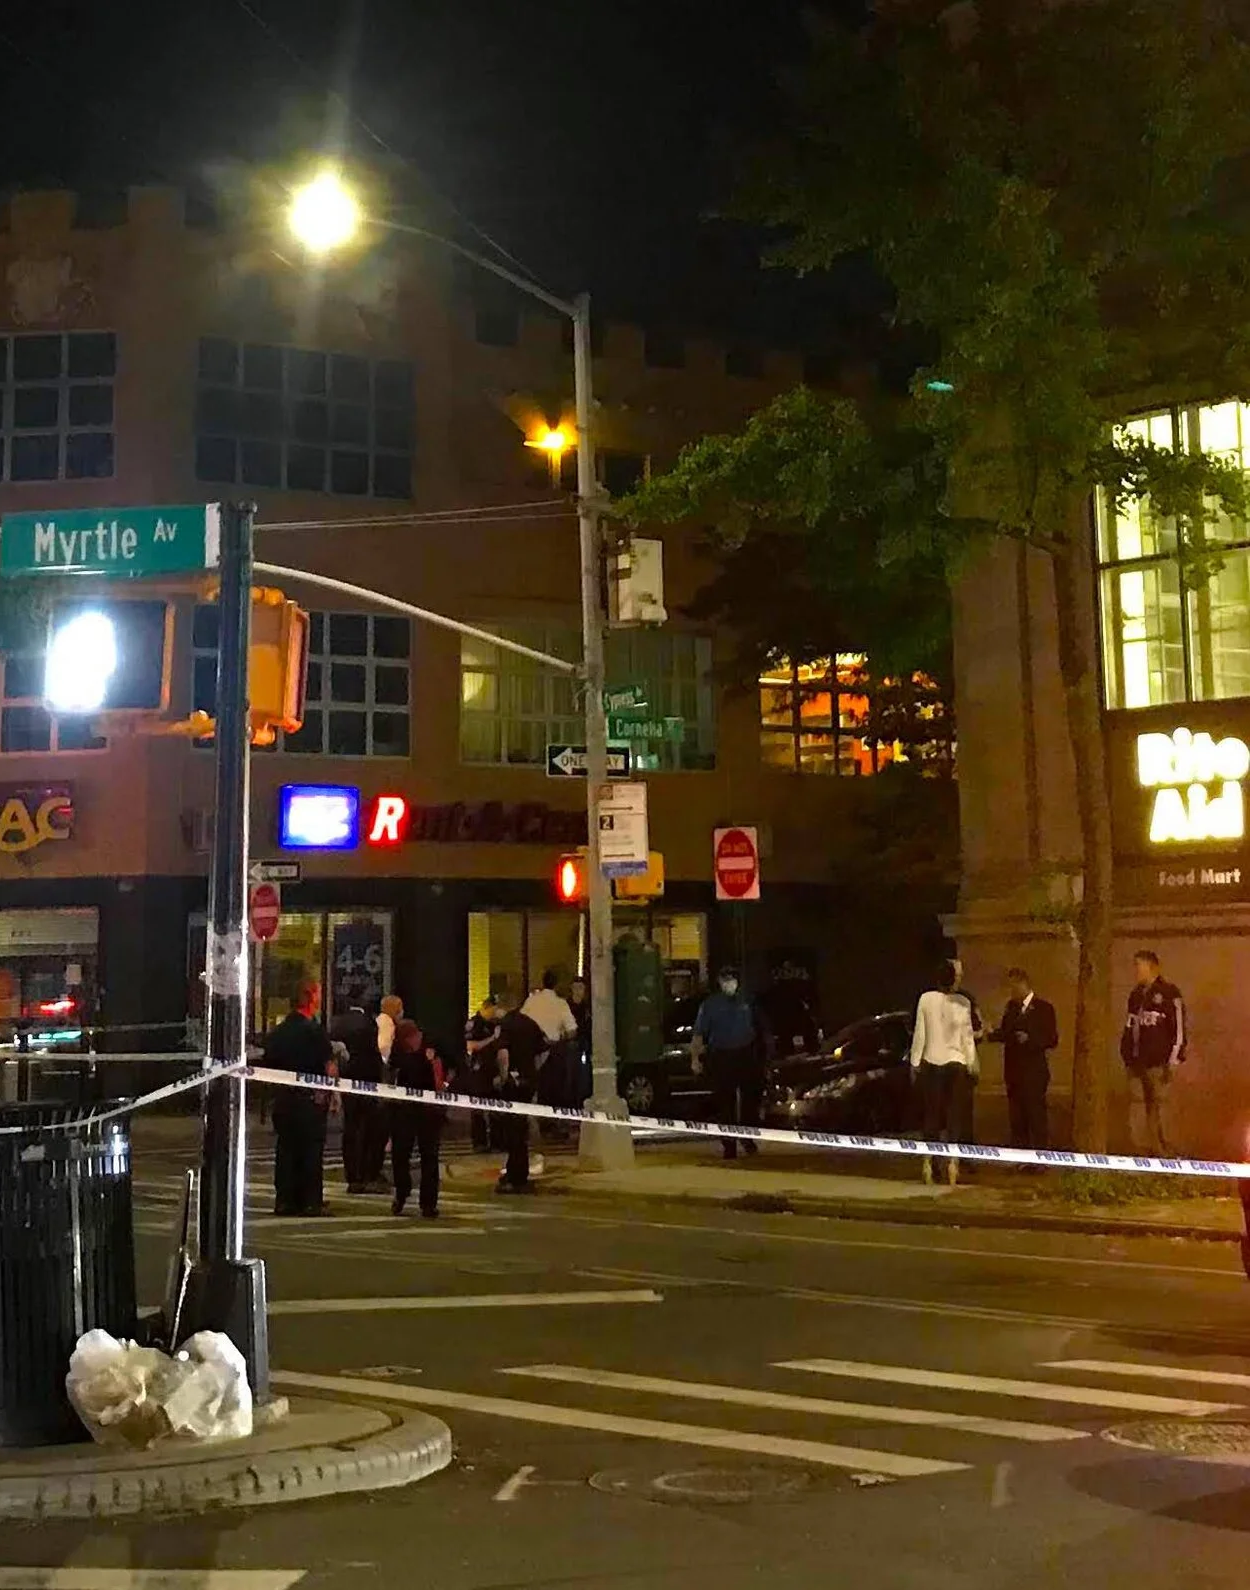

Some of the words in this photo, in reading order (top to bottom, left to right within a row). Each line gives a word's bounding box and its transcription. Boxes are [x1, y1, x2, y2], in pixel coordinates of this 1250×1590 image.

[34, 520, 138, 566] Myrtle
[153, 517, 177, 543] Av
[616, 718, 663, 738] Cornelia
[561, 756, 585, 767] ONE
[1149, 780, 1245, 842] Aid
[602, 816, 611, 830] 2
[1159, 869, 1195, 886] Food
[1201, 868, 1241, 884] Mart
[337, 944, 382, 974] 4-6
[296, 1071, 340, 1088] POLICE
[351, 1079, 378, 1092] LINE
[798, 1130, 841, 1144] POLICE
[850, 1135, 876, 1147] LINE
[900, 1139, 917, 1150] DO
[928, 1141, 950, 1153] NOT
[959, 1143, 1001, 1158] CROSS
[1035, 1150, 1077, 1163] POLICE
[1085, 1153, 1110, 1165] LINE
[1133, 1157, 1151, 1168] DO
[1159, 1159, 1183, 1170] NOT
[1190, 1161, 1231, 1173] CROSS
